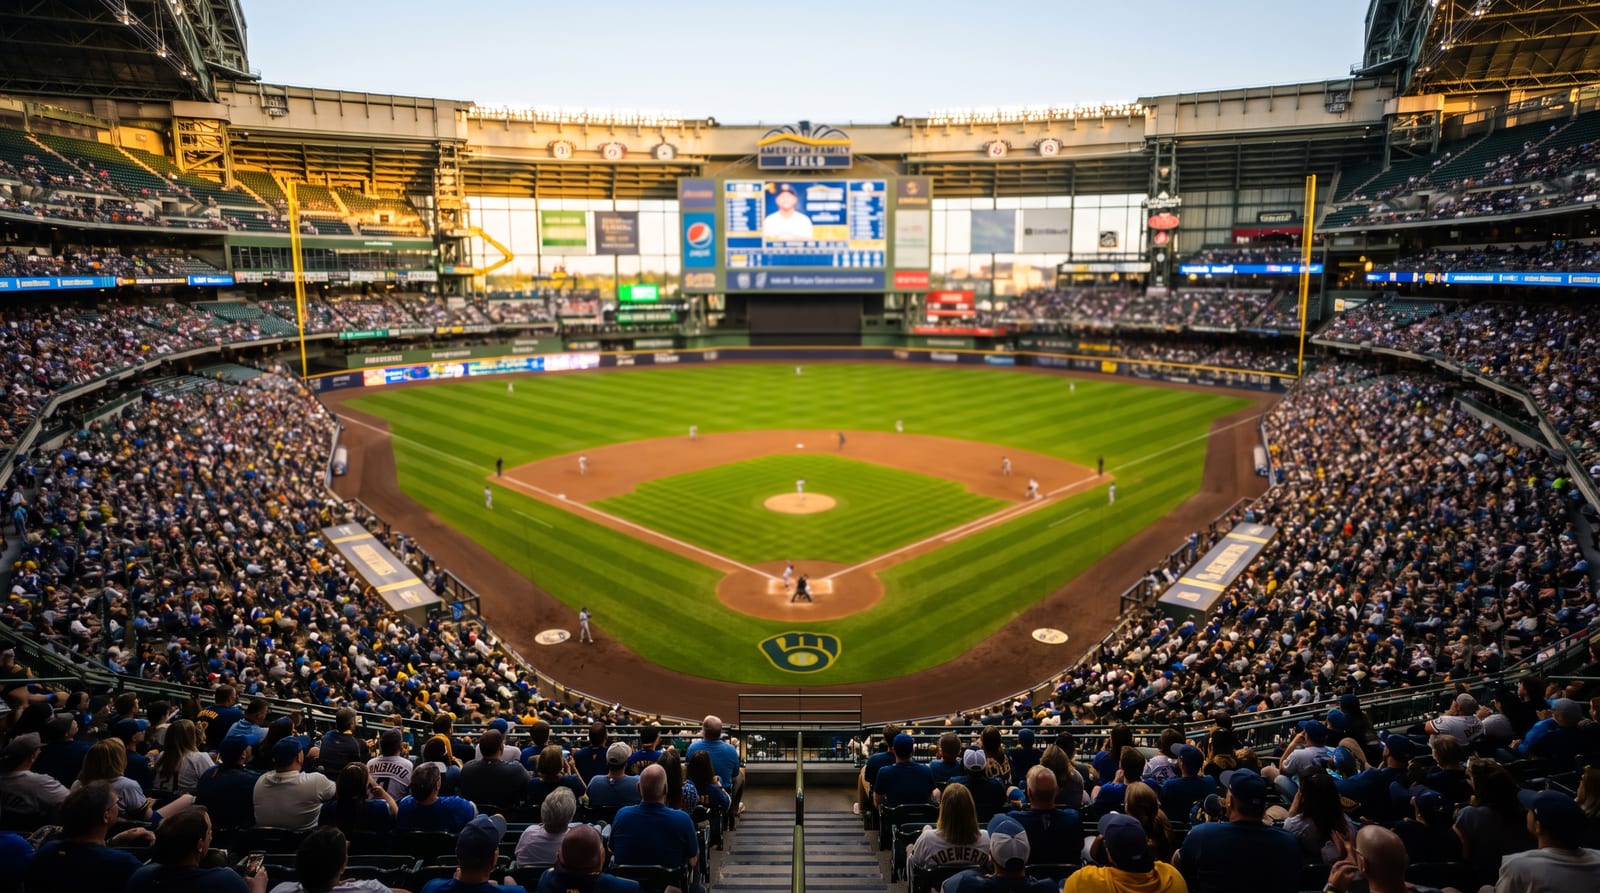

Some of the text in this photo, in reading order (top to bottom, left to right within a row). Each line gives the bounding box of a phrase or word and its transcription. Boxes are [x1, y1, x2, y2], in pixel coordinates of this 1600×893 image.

[760, 146, 850, 154] AMERICAN FAMILY
[786, 156, 825, 166] FIELD
